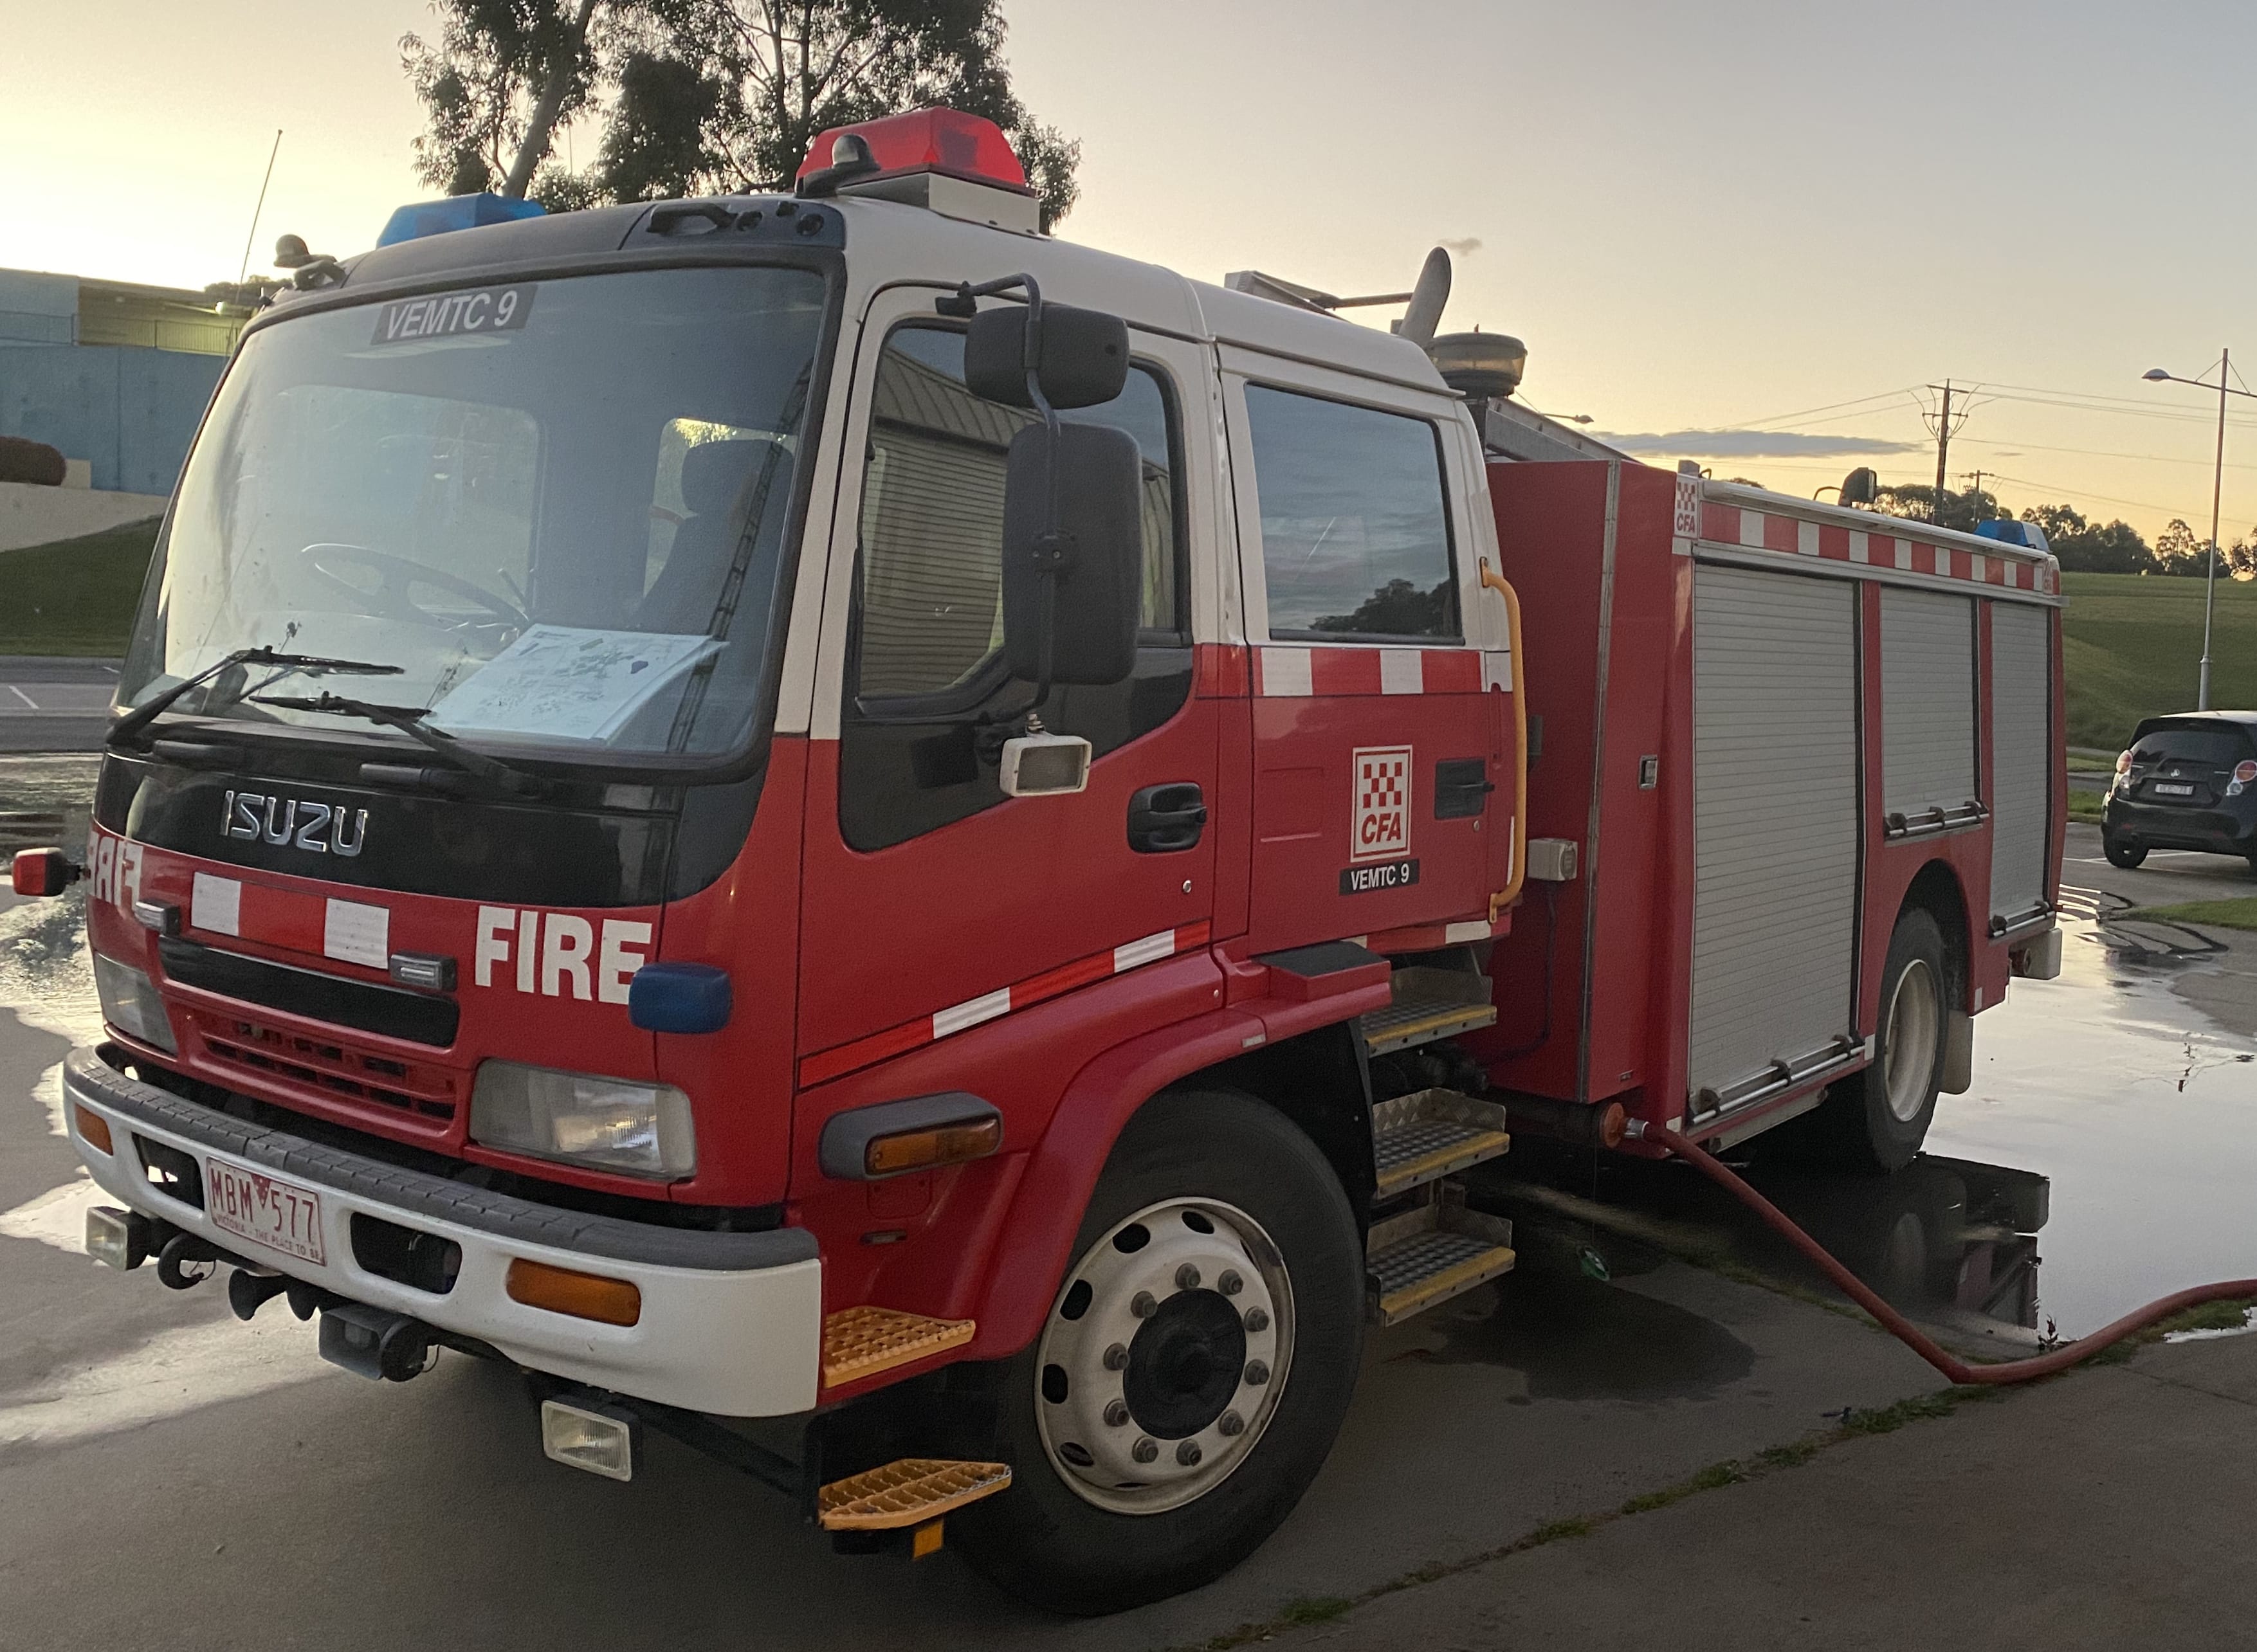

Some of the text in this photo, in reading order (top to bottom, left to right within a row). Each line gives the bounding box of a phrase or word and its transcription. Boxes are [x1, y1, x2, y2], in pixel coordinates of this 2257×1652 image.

[387, 290, 518, 340] VEMTC 9
[1676, 513, 1695, 533] CFA
[220, 790, 369, 857] ISUZU
[1361, 812, 1402, 844] CFA
[1351, 863, 1410, 891] VEMTC 9
[475, 905, 652, 1005] FIRE
[211, 1167, 314, 1243] MBM 577
[255, 1228, 269, 1242] THE
[296, 1244, 307, 1256] TO
[309, 1248, 320, 1260] BE
